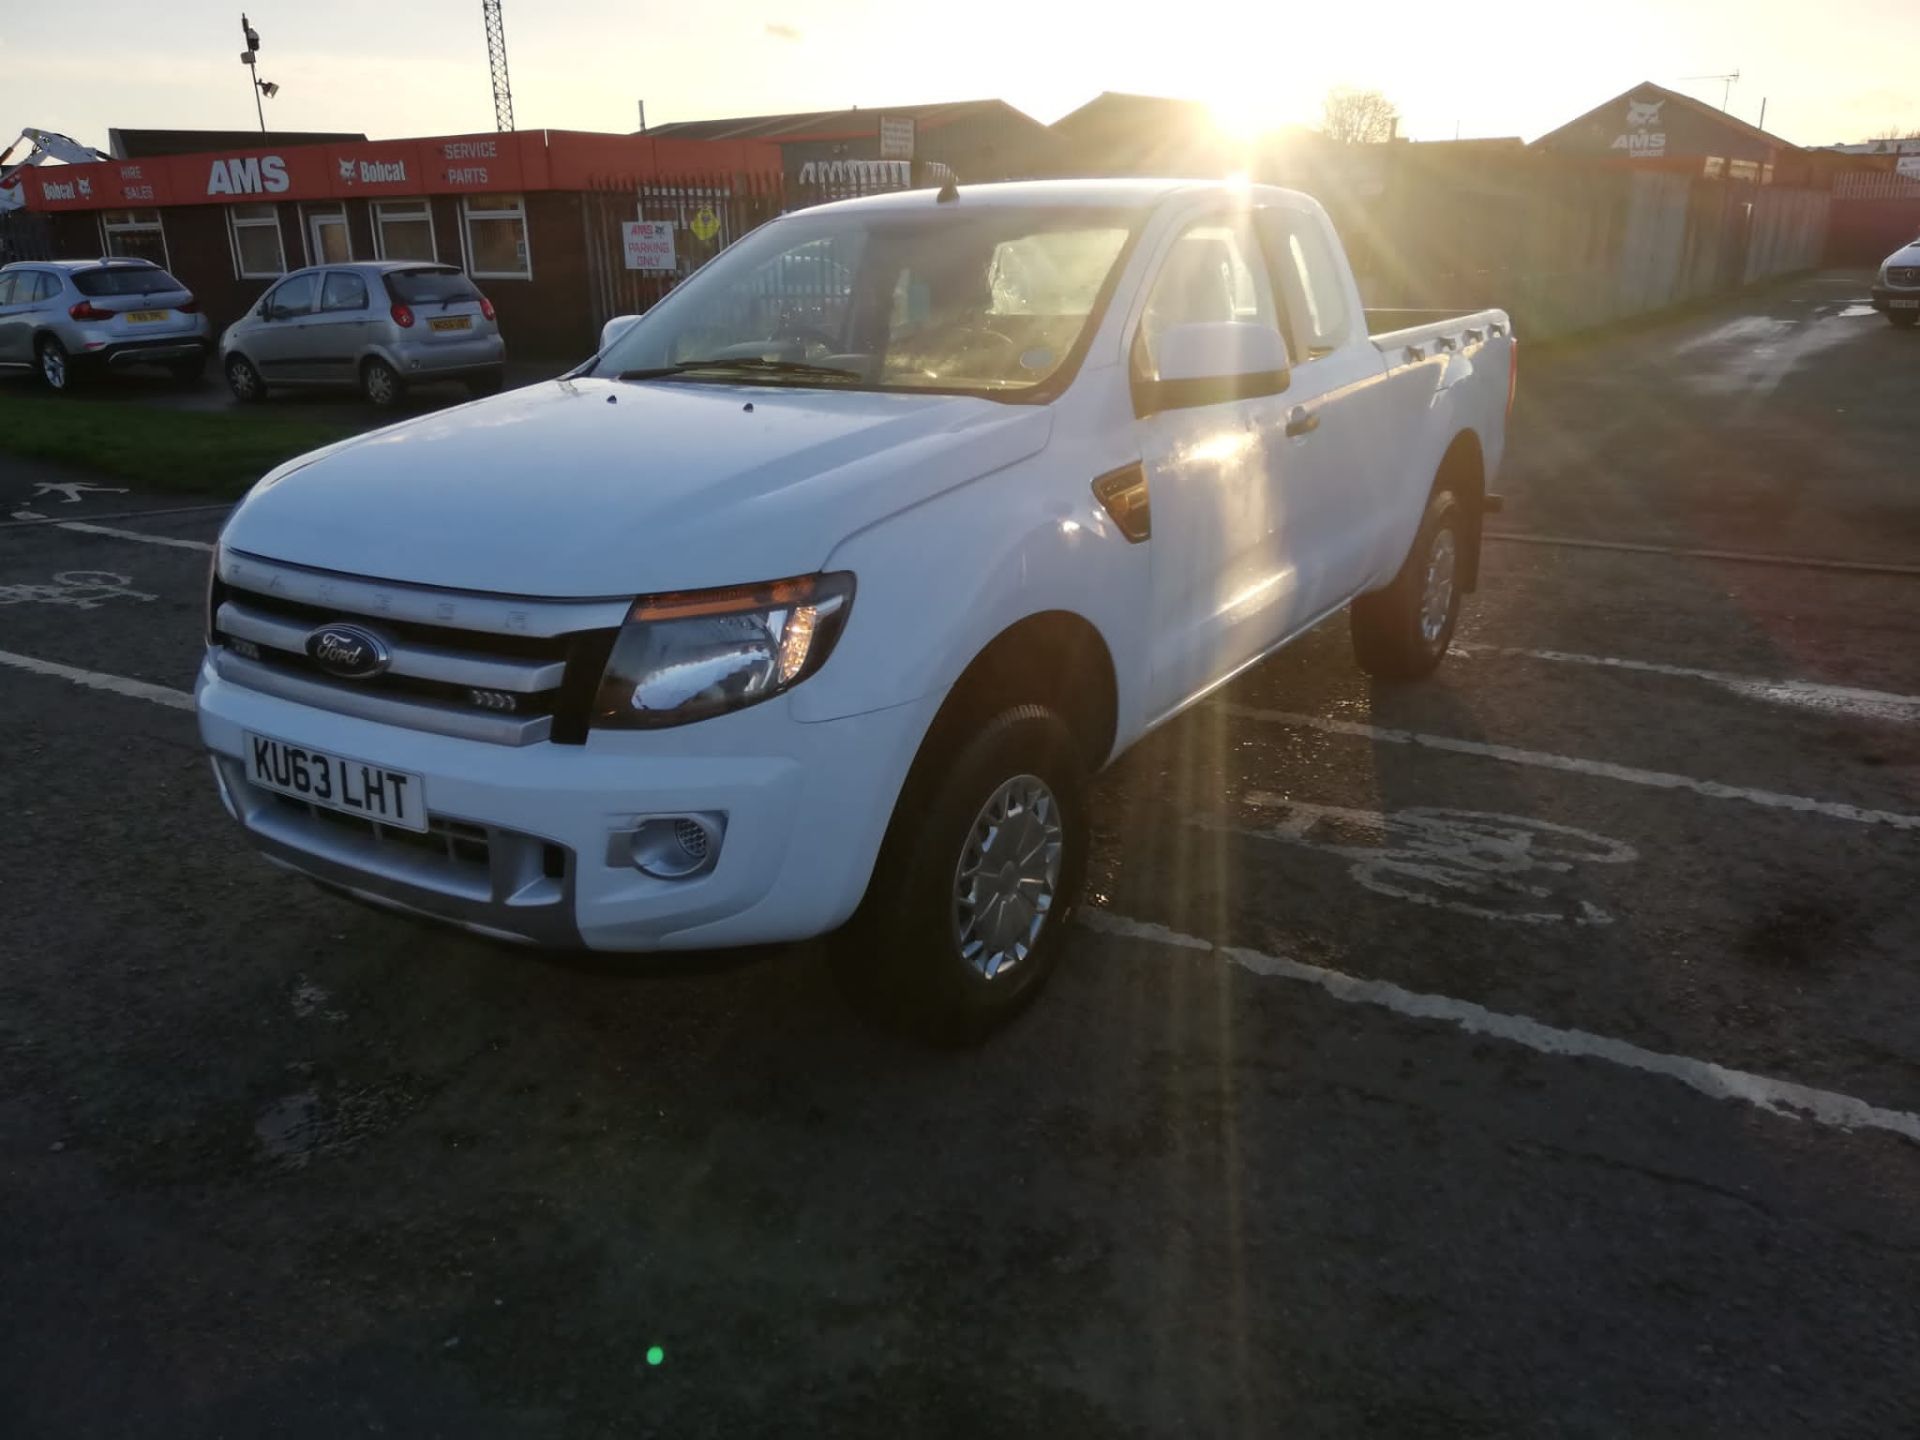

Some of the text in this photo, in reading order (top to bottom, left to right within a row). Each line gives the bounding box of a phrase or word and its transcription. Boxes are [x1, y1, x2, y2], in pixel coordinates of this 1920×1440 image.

[1610, 133, 1666, 149] AMS
[444, 141, 497, 159] SERVICE
[121, 165, 142, 180] HIRE
[207, 156, 290, 195] AMS
[360, 160, 406, 182] Bobcat
[447, 166, 488, 184] PARTS
[124, 185, 154, 199] SALES
[631, 224, 653, 236] AMS
[628, 242, 670, 254] PARKING
[636, 255, 660, 266] ONLY
[317, 632, 362, 664] Ford
[253, 737, 407, 819] KU63 LHT
